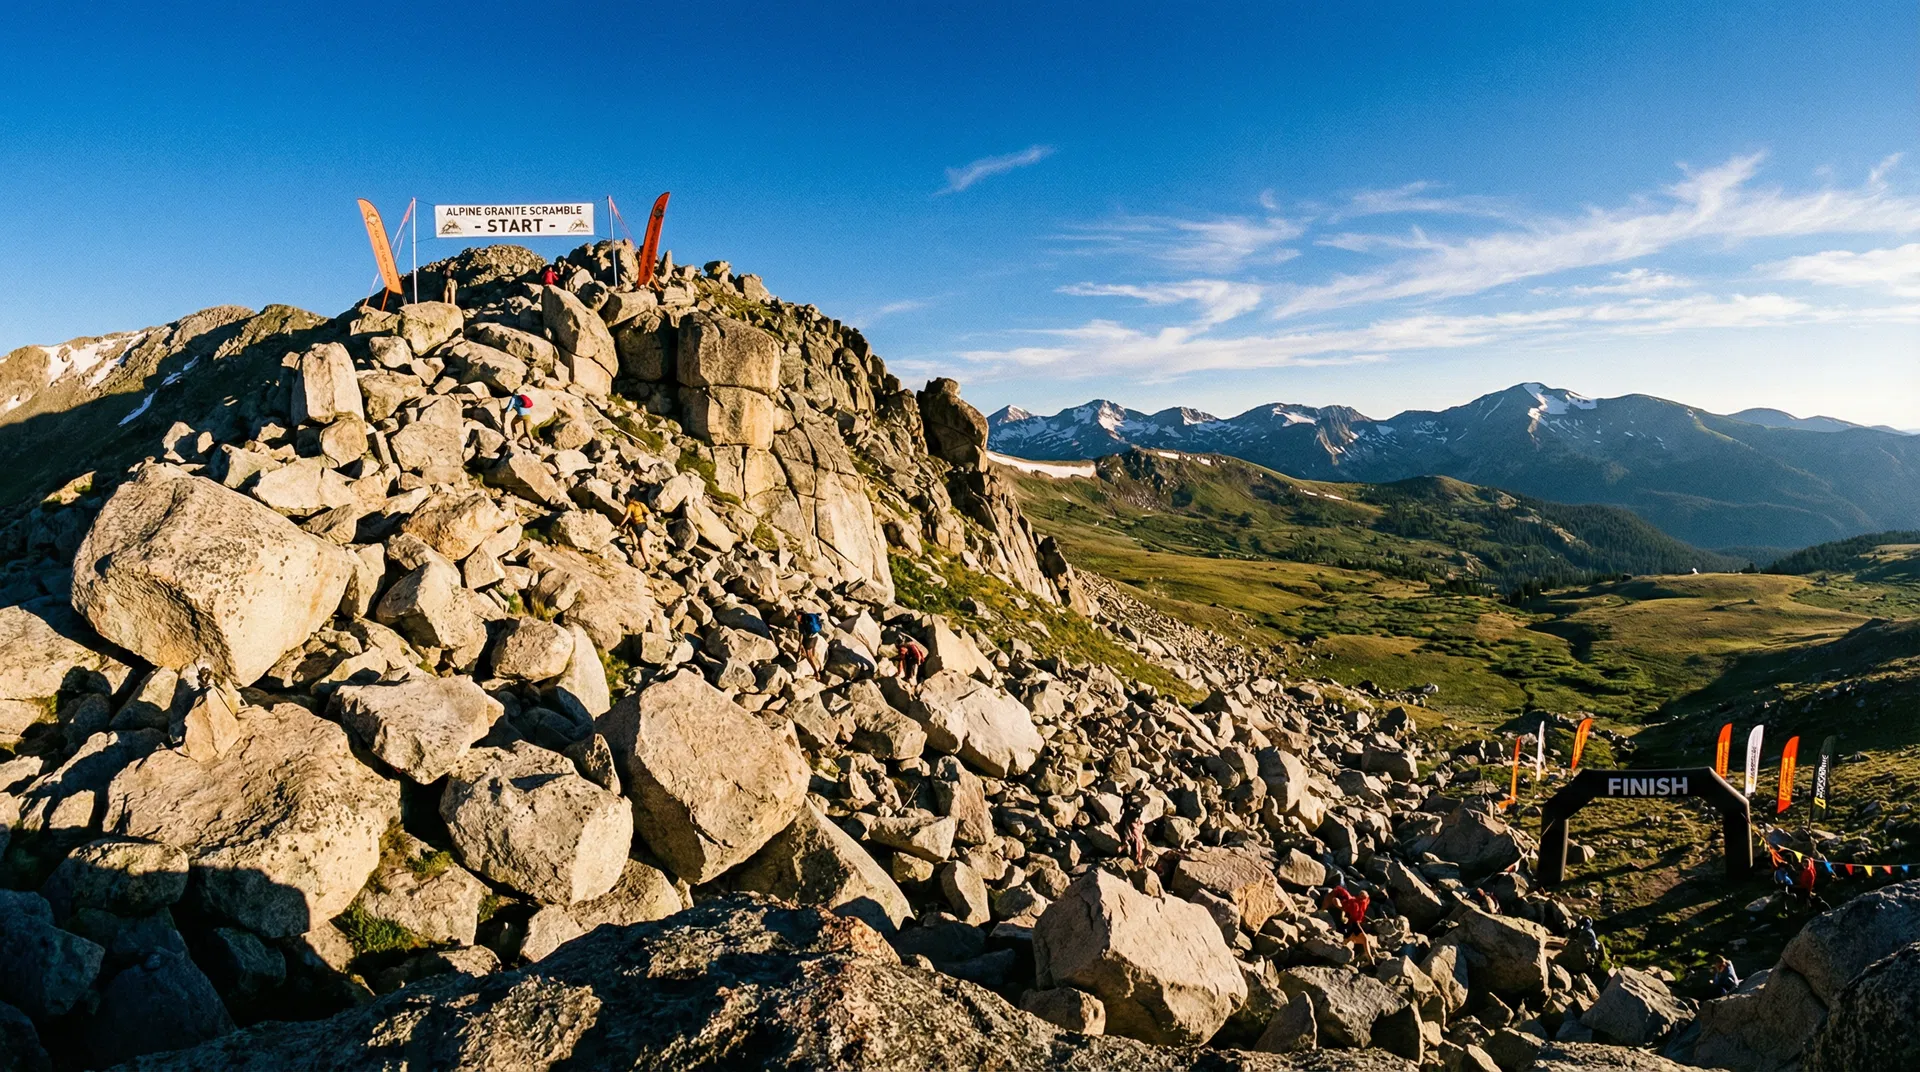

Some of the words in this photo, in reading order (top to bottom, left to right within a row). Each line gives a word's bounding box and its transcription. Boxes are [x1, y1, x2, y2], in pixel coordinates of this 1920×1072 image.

[446, 207, 482, 216] ALPINE
[484, 206, 527, 216] GRANITE
[529, 205, 582, 215] SCRAMBLE
[487, 219, 543, 233] START
[1608, 777, 1688, 796] FINISH
